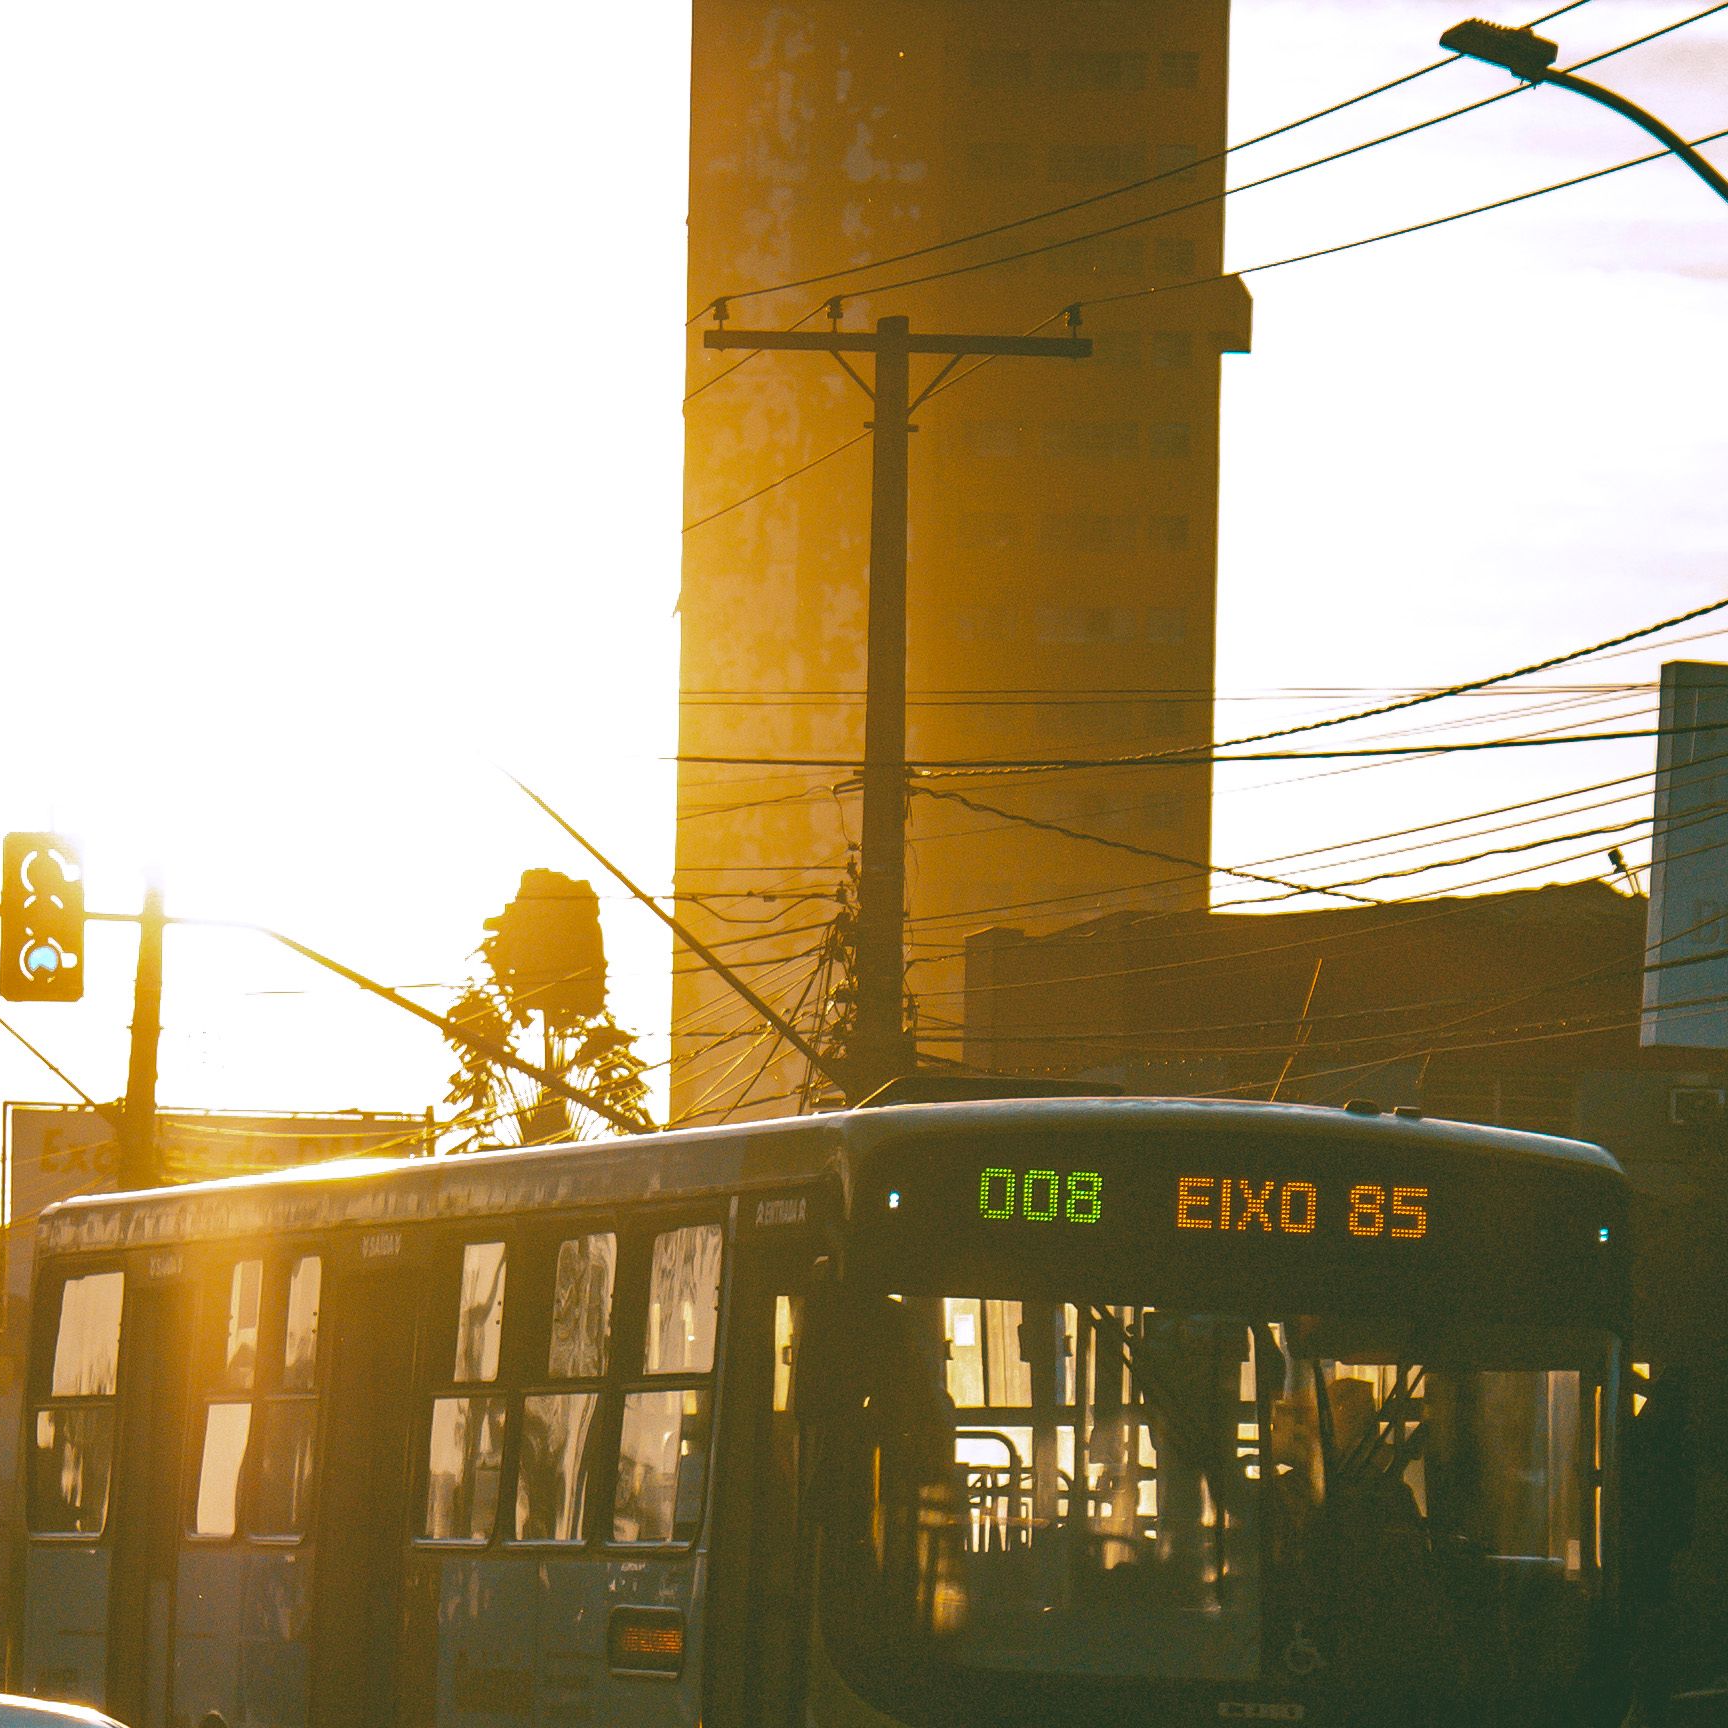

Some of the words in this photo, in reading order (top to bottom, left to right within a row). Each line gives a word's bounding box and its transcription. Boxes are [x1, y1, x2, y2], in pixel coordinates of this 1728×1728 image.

[978, 1166, 1104, 1225] 008
[1175, 1176, 1318, 1235] EIXO
[1347, 1185, 1430, 1239] 85
